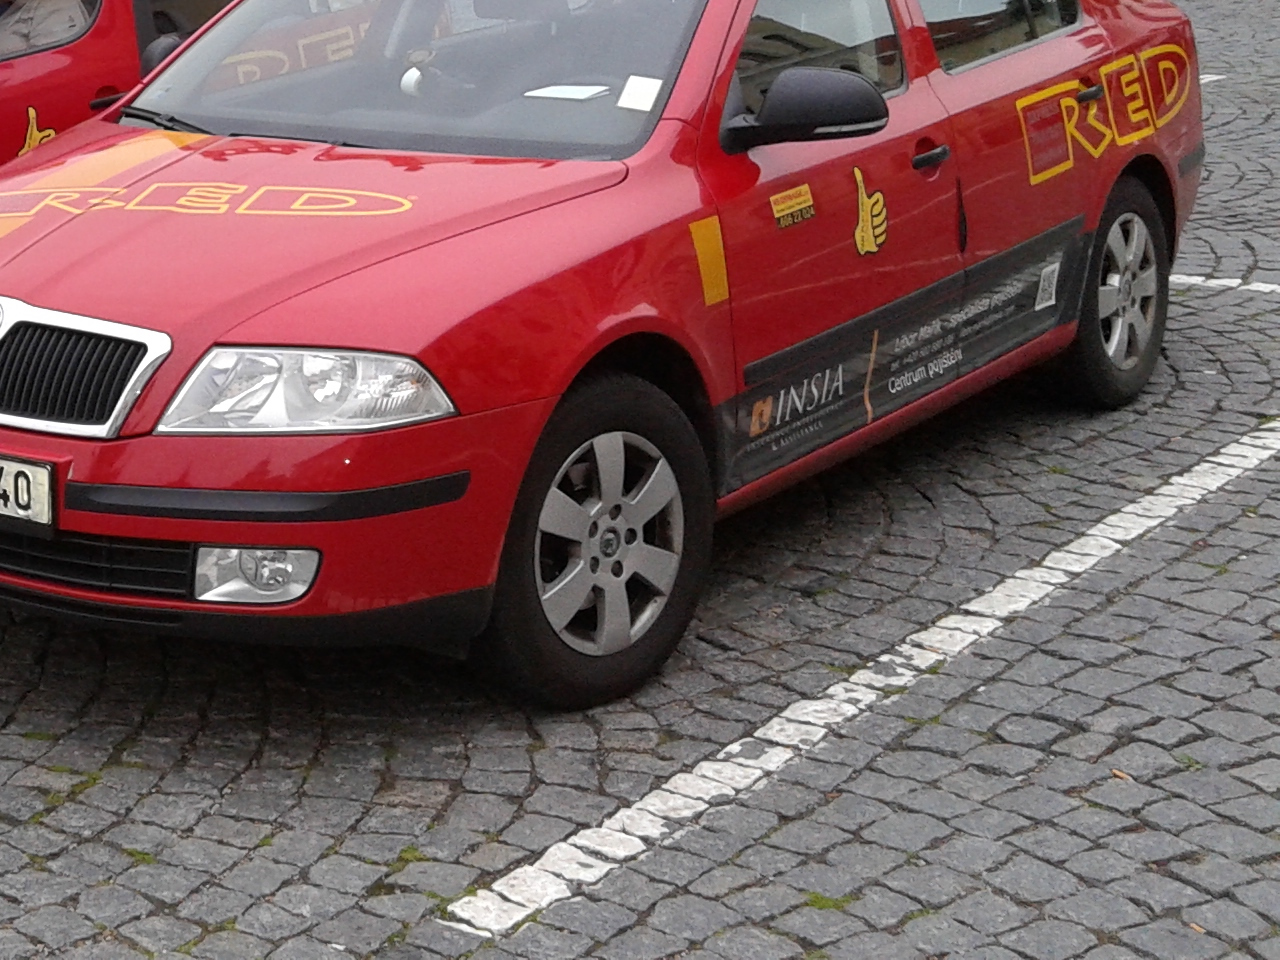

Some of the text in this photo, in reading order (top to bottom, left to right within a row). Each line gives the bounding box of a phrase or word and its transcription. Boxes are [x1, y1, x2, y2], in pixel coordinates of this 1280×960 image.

[1015, 43, 1191, 186] RED
[775, 363, 844, 426] INSIA
[888, 365, 928, 394] Centrum
[927, 347, 964, 379] pojištění
